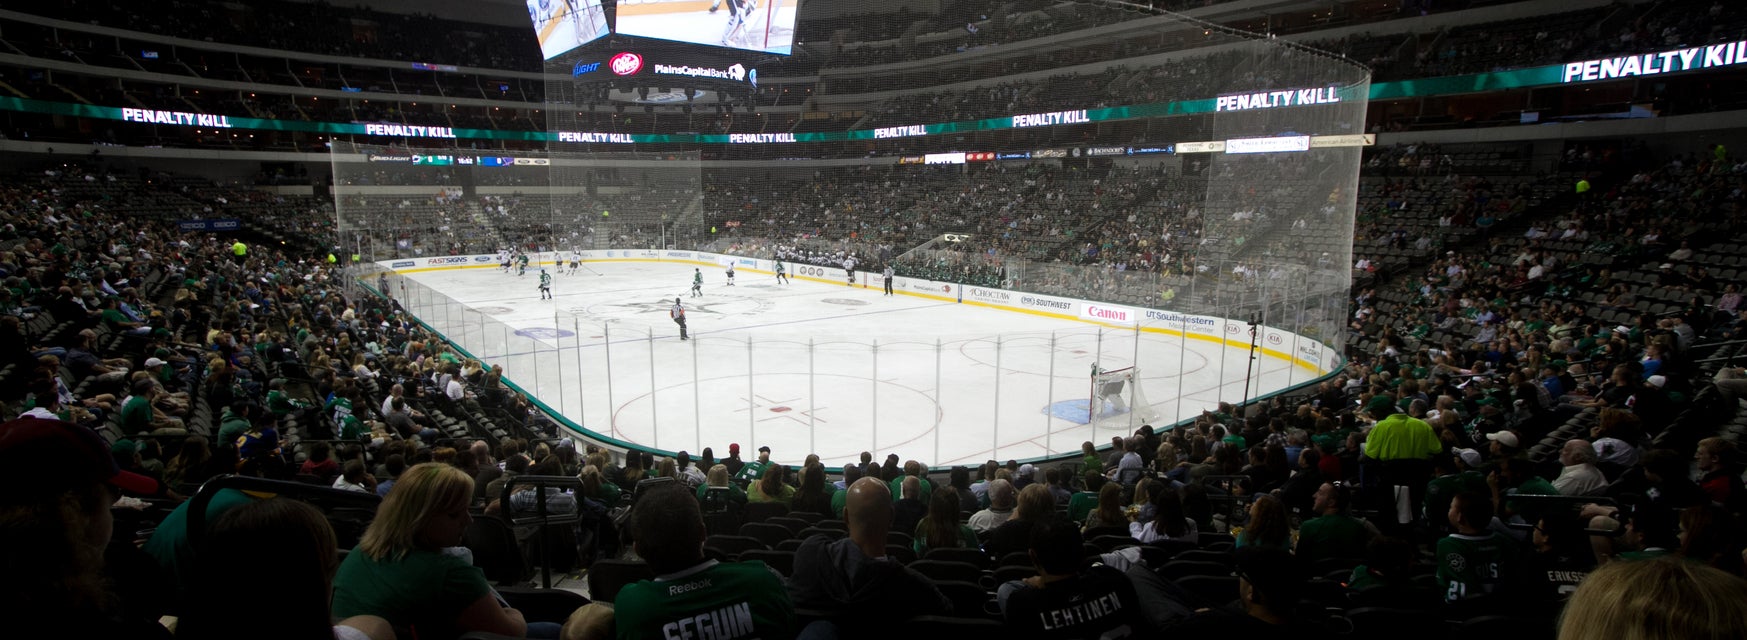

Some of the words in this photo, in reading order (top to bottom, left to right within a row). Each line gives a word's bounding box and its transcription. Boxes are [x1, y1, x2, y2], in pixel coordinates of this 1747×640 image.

[1564, 47, 1700, 83] PENALTY
[1703, 40, 1747, 68] KIL
[1216, 89, 1296, 112] PENALTY
[1297, 87, 1340, 105] KILL
[122, 107, 195, 126] PENALTY
[197, 113, 232, 128] KILL
[1012, 111, 1063, 127] PENALTY
[1063, 110, 1090, 124] KILL
[366, 123, 427, 137] PENALTY
[427, 126, 456, 138] KILL
[558, 132, 608, 143] PENALTY
[609, 133, 634, 143] KILL
[730, 133, 774, 143] PENALTY
[775, 133, 796, 143] KILL
[874, 127, 908, 138] PENALTY
[908, 125, 927, 136] KILL
[428, 256, 468, 265] FASTSIGNS
[973, 287, 1011, 300] CHOCTAW
[1036, 299, 1072, 310] SOUTHWEST
[1088, 305, 1127, 321] Canon
[1547, 570, 1588, 583] ERIKSS
[668, 577, 713, 597] Reebok
[1447, 580, 1467, 600] 21
[1040, 591, 1122, 630] LEHTINEN
[662, 601, 754, 640] SEGUIN
